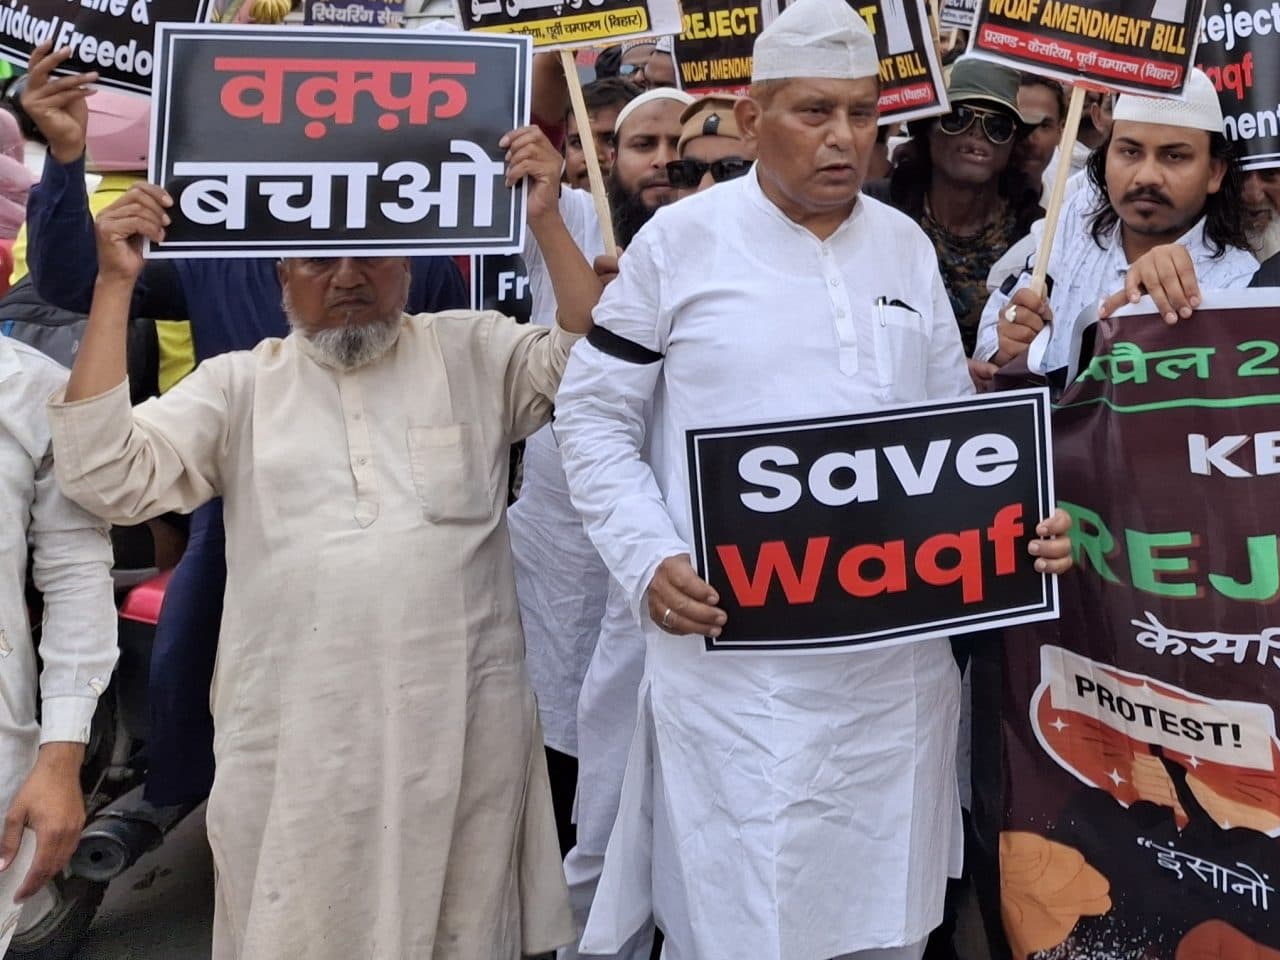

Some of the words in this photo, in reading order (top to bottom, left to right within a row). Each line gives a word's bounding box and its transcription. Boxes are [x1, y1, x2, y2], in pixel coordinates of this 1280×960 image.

[0, 0, 59, 46] vidual
[53, 20, 153, 76] Freedo
[1040, 0, 1152, 49] AMENDMENT
[1151, 20, 1186, 55] BILL
[681, 61, 709, 82] WQAF
[899, 53, 927, 80] BILL
[1199, 53, 1254, 101] aqf
[173, 139, 505, 230] बचाओ
[737, 432, 1019, 514] Save
[715, 501, 1025, 608] Waqf
[1075, 673, 1244, 750] PROTEST!
